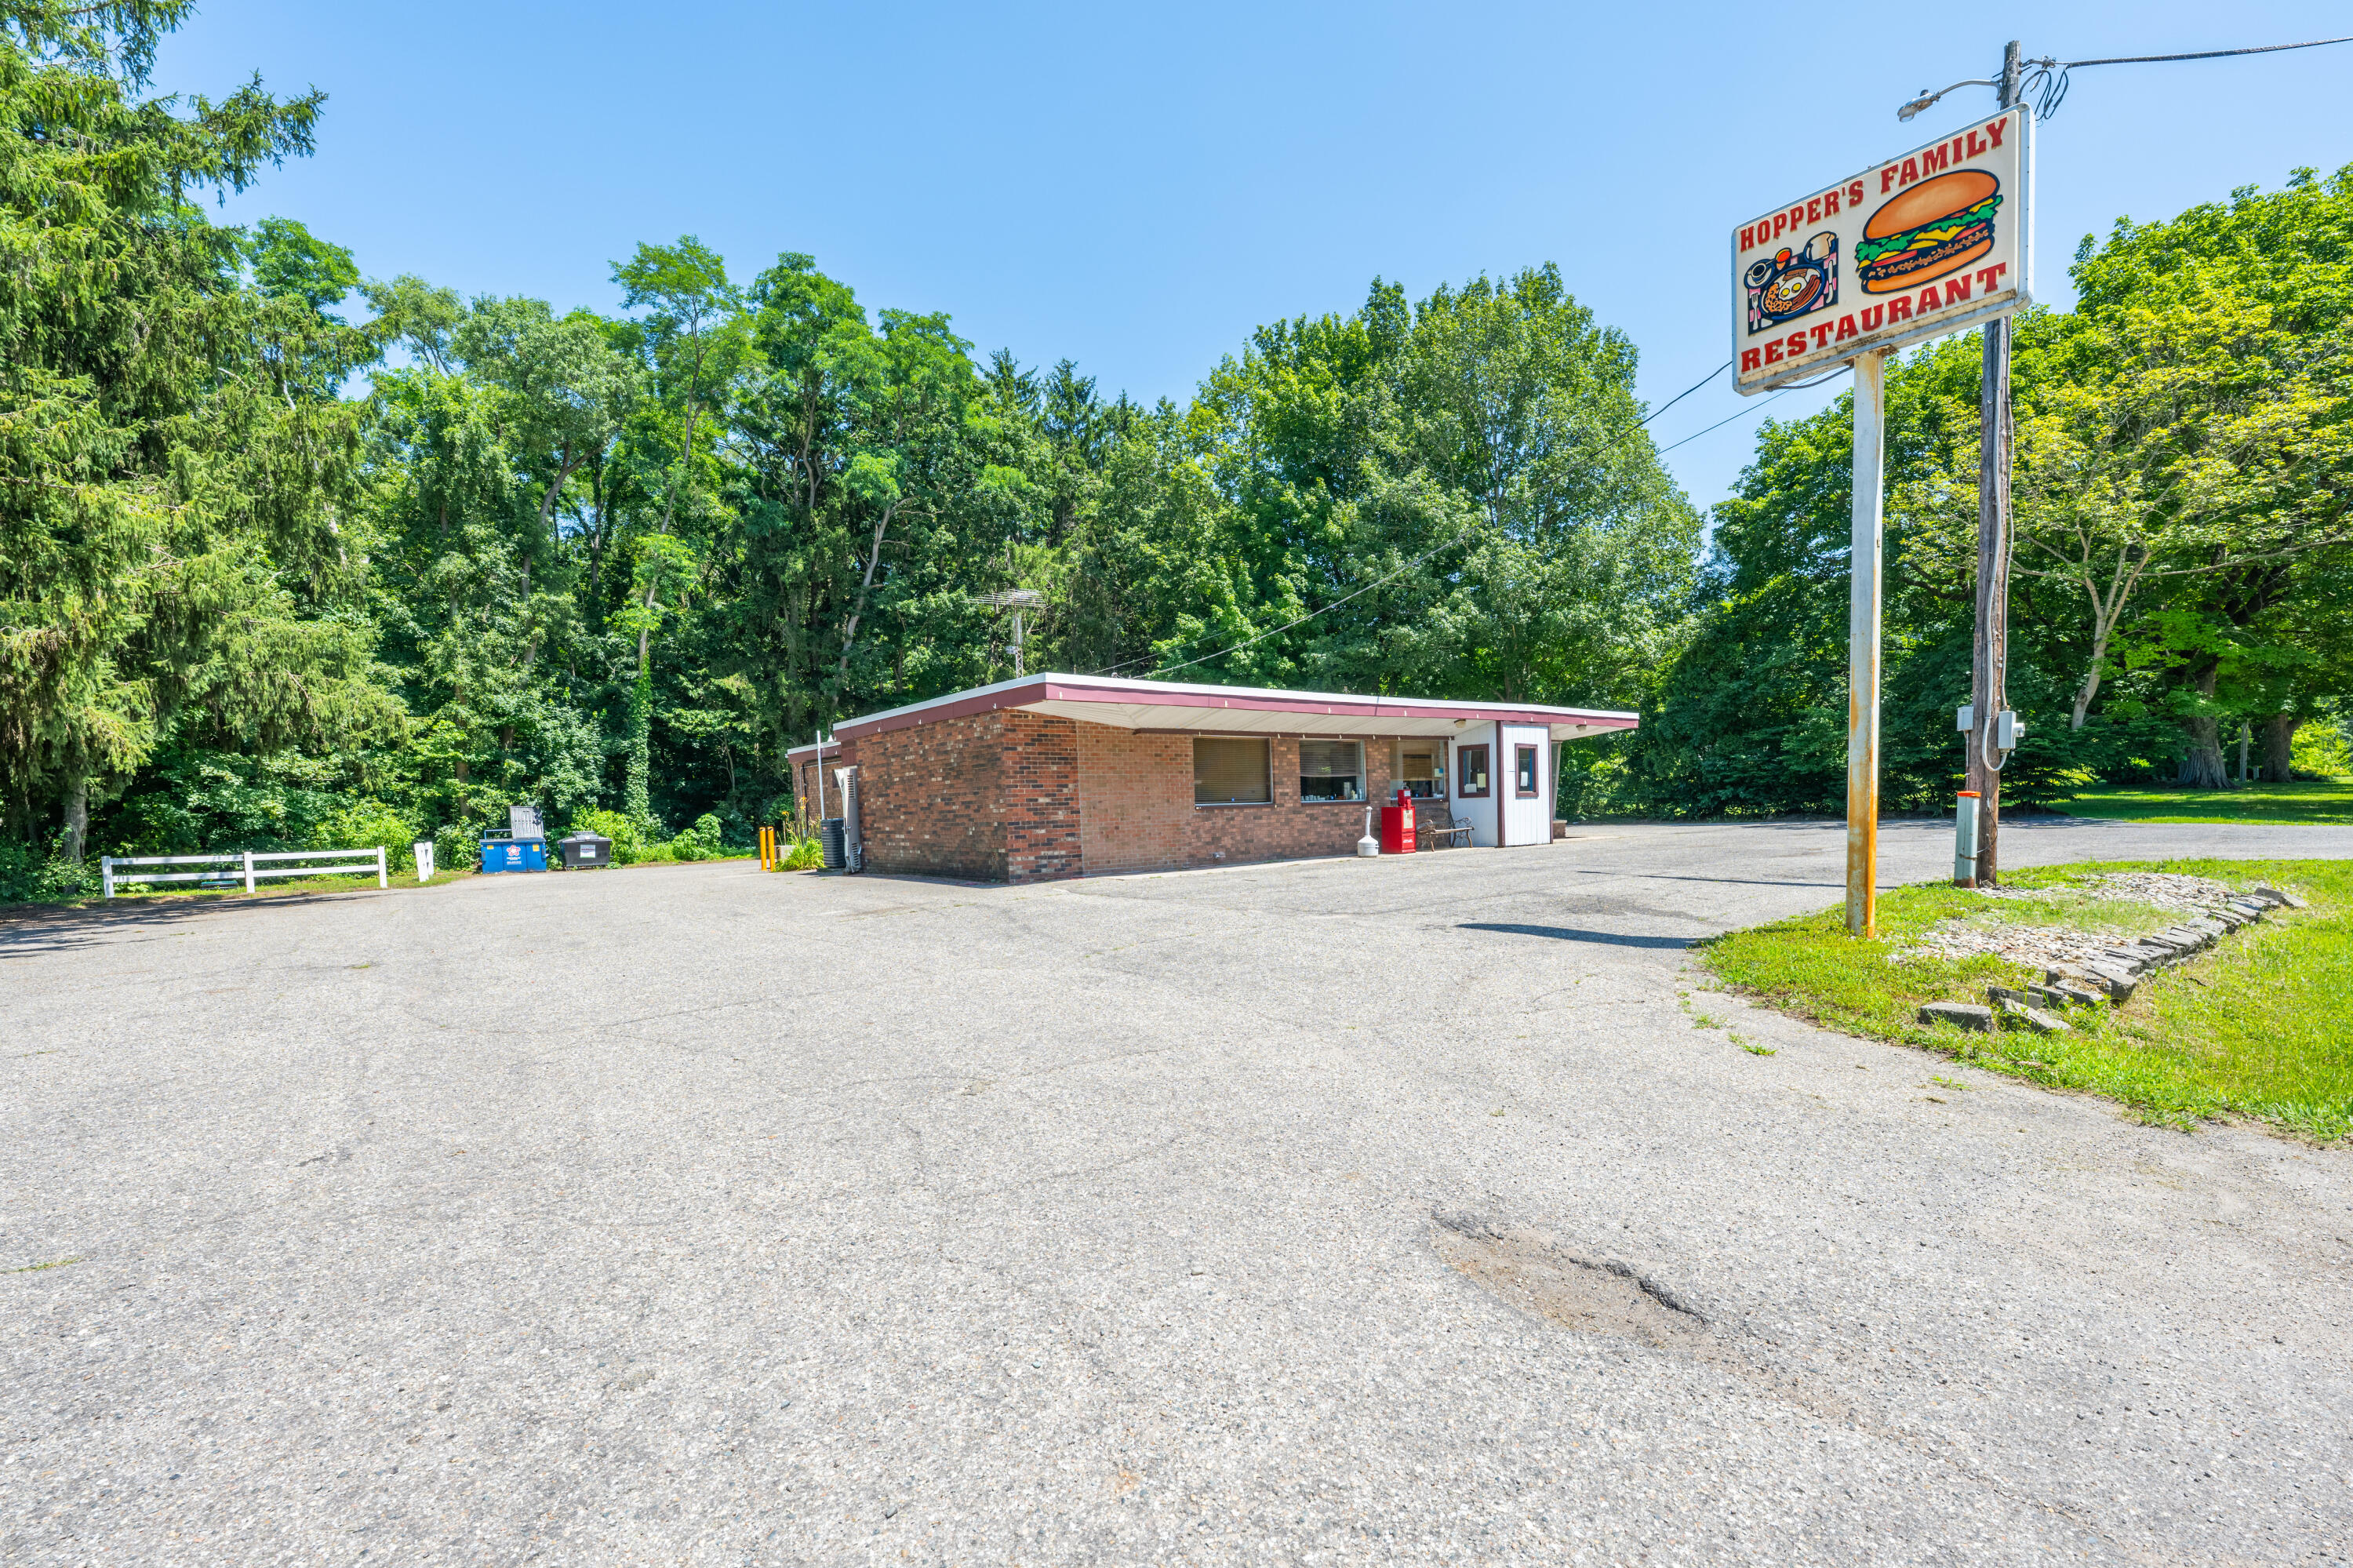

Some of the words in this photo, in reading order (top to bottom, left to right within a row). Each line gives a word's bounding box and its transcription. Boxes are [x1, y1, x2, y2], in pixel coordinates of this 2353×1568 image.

[1740, 180, 1864, 252] HOPPER'S
[1881, 117, 2007, 193] FAMILY
[1741, 262, 2007, 373] RESTAURANT
